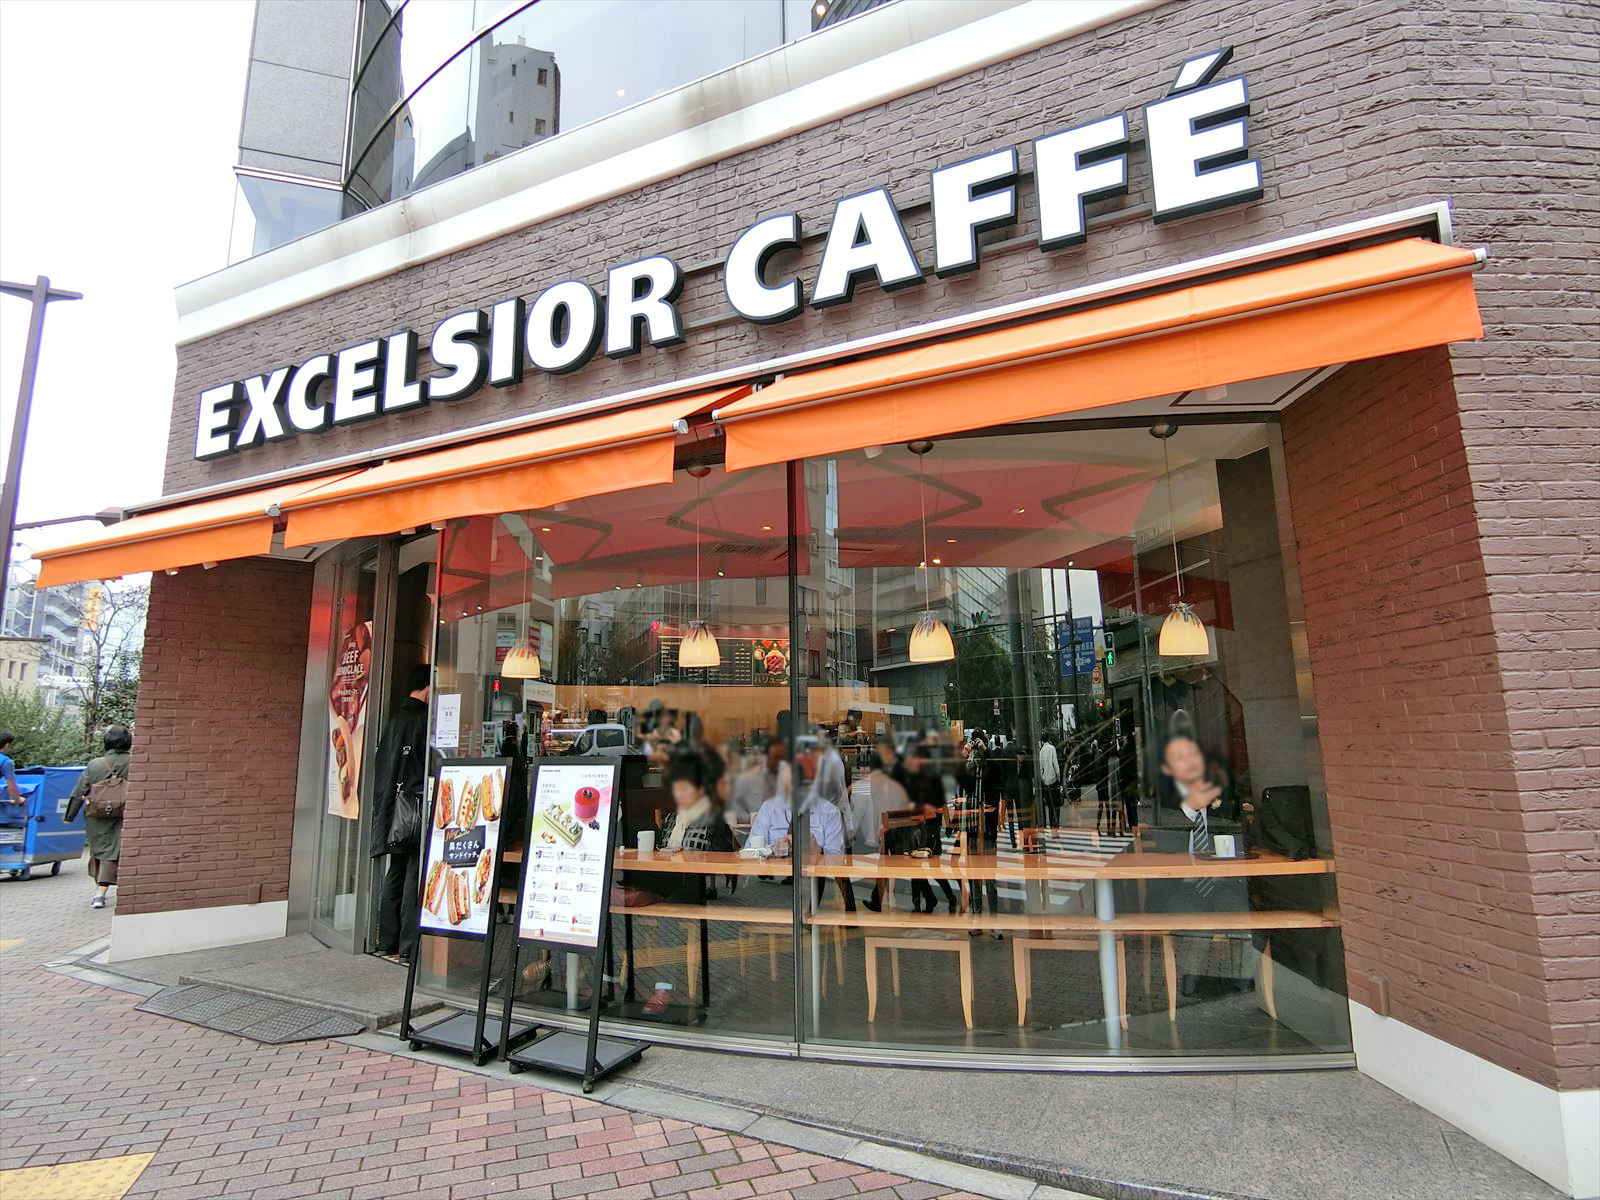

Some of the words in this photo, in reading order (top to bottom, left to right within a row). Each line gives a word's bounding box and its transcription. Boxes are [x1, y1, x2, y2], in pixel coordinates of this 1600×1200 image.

[194, 256, 685, 460] EXCELSIOR
[724, 46, 1263, 325] CAFFÉ
[342, 650, 359, 665] BEEF
[448, 840, 480, 851] 具だくさん
